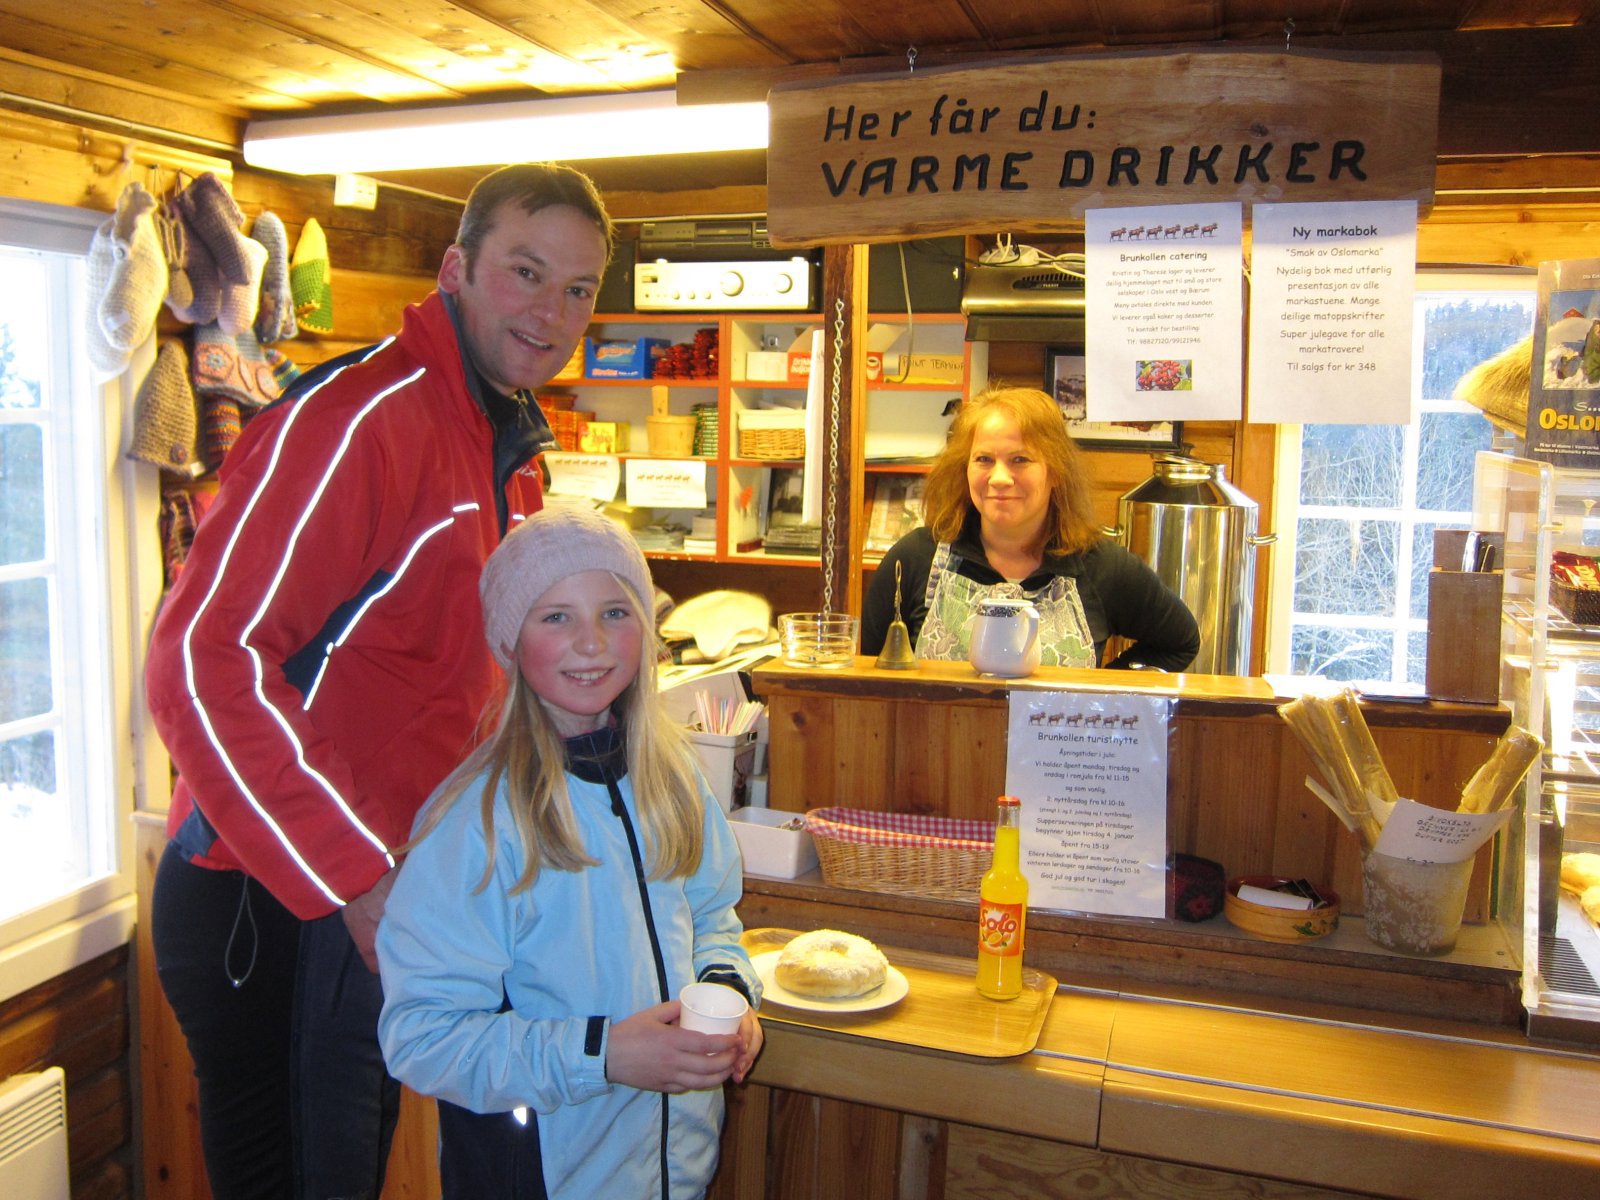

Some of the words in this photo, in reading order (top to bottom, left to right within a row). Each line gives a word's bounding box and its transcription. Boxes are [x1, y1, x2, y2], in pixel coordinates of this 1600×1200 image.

[823, 105, 910, 143] Her
[930, 93, 1001, 136] får
[1019, 89, 1096, 132] du:
[821, 151, 1034, 198] VARME
[1057, 140, 1369, 189] DRIKKER
[1293, 227, 1311, 240] Ny
[1317, 225, 1377, 236] markabok
[1120, 253, 1166, 262] Brunkollen
[1170, 252, 1207, 261] catering
[1277, 266, 1311, 277] Nydelig
[1356, 266, 1392, 276] utførlig
[1288, 282, 1348, 292] presentasjon
[1363, 281, 1380, 289] alle
[1350, 297, 1380, 306] Mange
[1281, 312, 1310, 322] deilige
[1314, 312, 1385, 322] matoppskrifter
[1280, 330, 1307, 339] Super
[1310, 330, 1348, 340] julegave
[1299, 345, 1364, 353] markatravere!
[1302, 362, 1324, 373] salgs
[1038, 732, 1084, 742] Brunkollen
[1087, 735, 1138, 746] turisthytte
[1060, 748, 1097, 757] Åpningstider
[980, 909, 1017, 933] Solo
